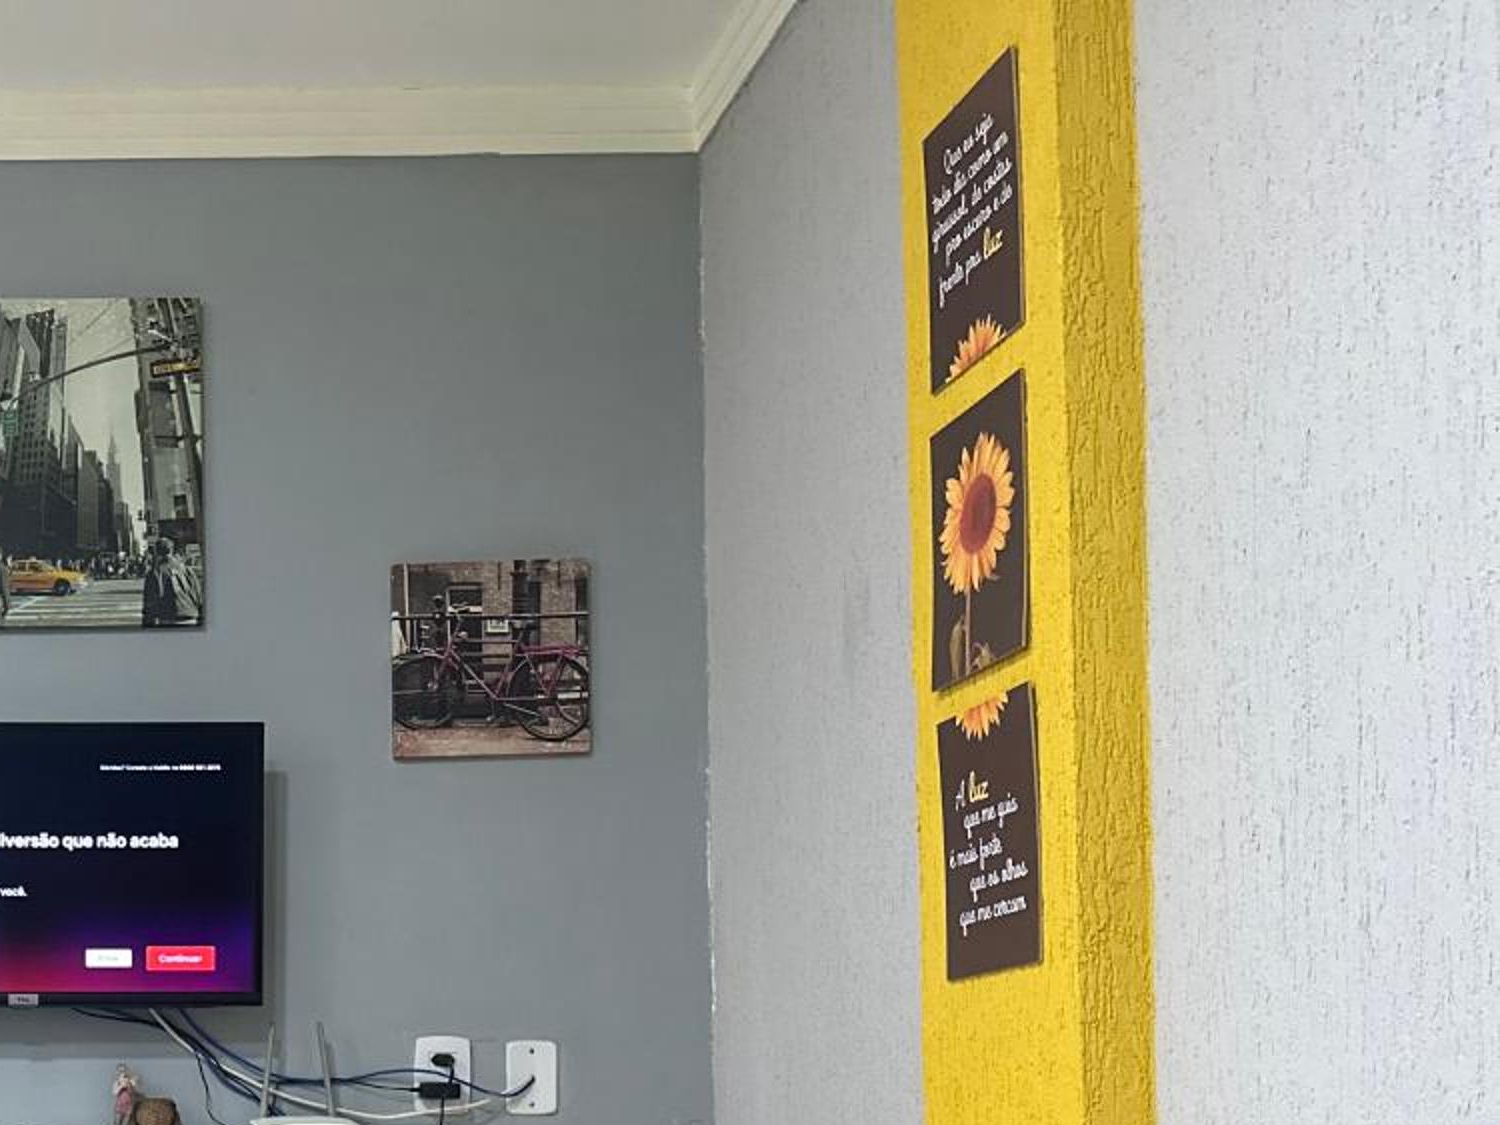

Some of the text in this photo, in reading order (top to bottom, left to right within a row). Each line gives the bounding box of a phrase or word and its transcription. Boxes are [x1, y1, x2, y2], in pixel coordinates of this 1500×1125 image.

[944, 147, 962, 174] Que
[984, 227, 1003, 260] luz
[956, 770, 989, 811] A luz
[964, 792, 1019, 839] que me guia
[62, 834, 94, 851] que
[96, 832, 127, 849] não
[129, 832, 179, 849] acaba
[957, 843, 978, 866] mais
[979, 833, 1002, 871] forte
[0, 886, 28, 896] você.
[969, 857, 1028, 903] que os olhos
[960, 909, 976, 936] que
[978, 905, 992, 921] me
